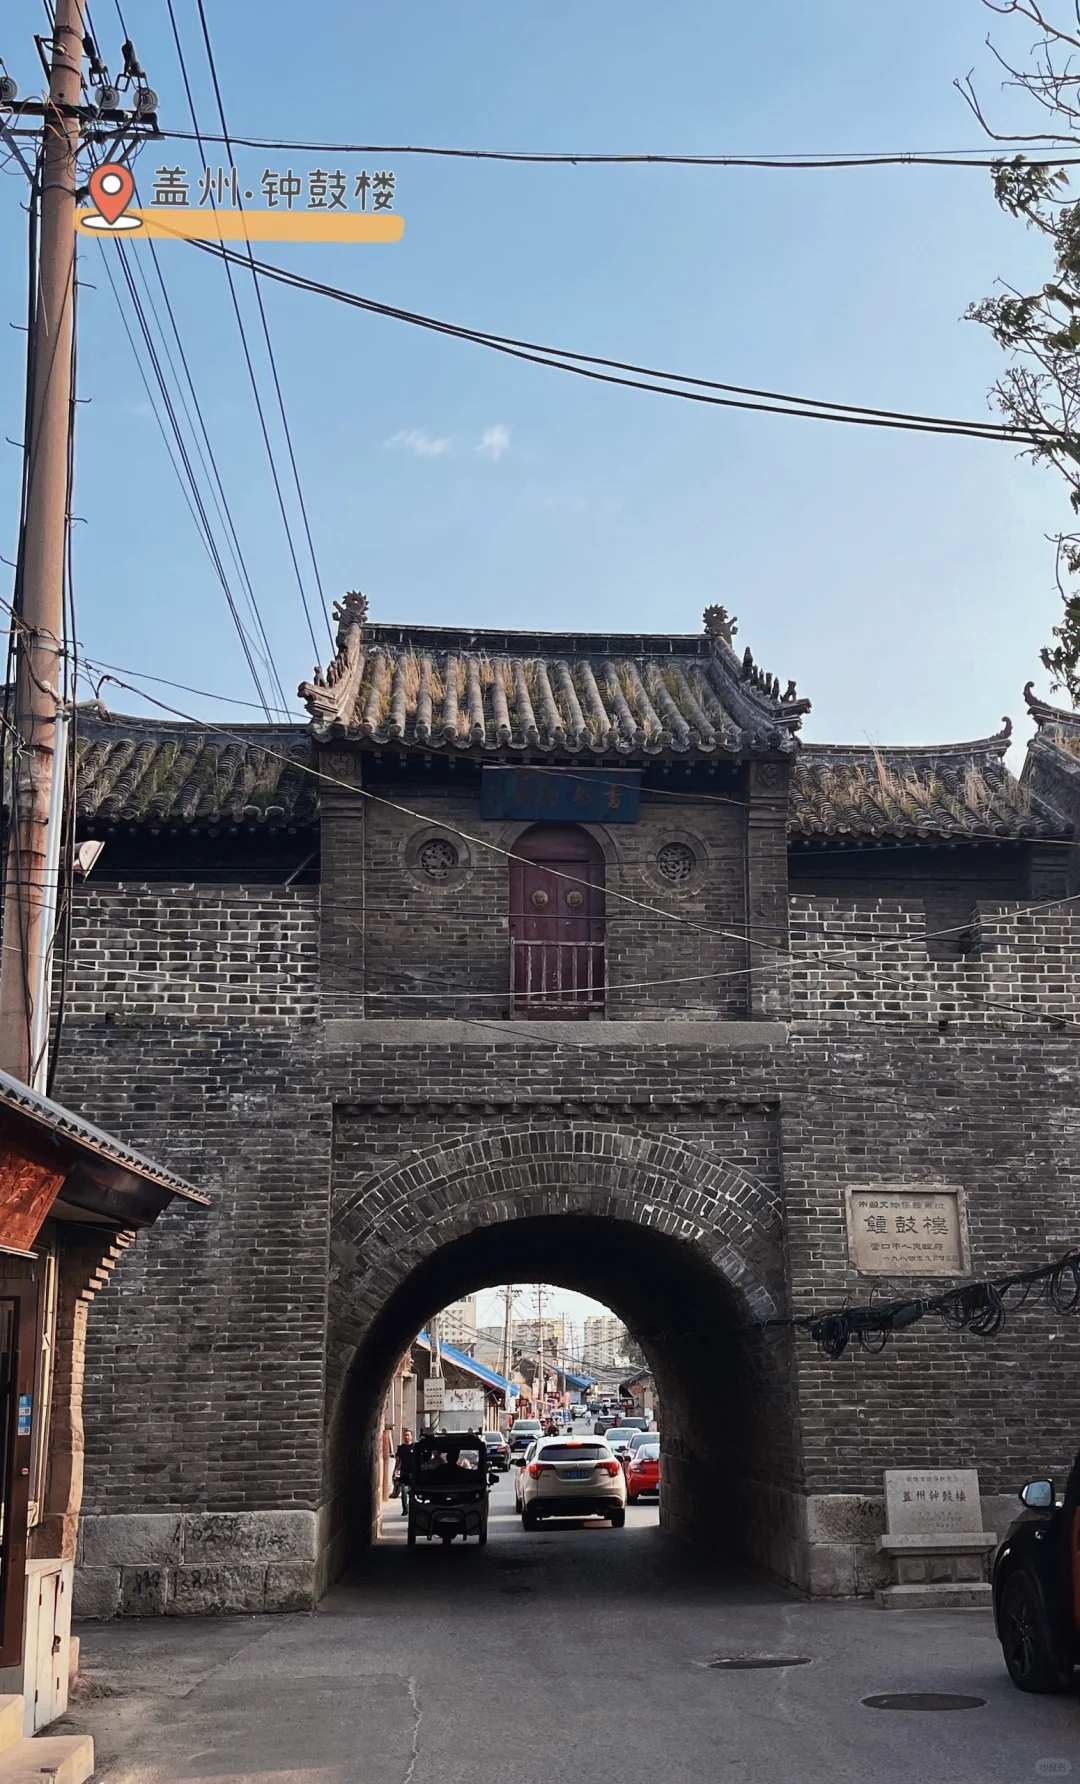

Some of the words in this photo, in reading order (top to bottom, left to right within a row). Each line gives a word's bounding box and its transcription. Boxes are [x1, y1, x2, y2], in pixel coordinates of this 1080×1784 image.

[903, 1490, 967, 1502] 盖州钟鼓楼
